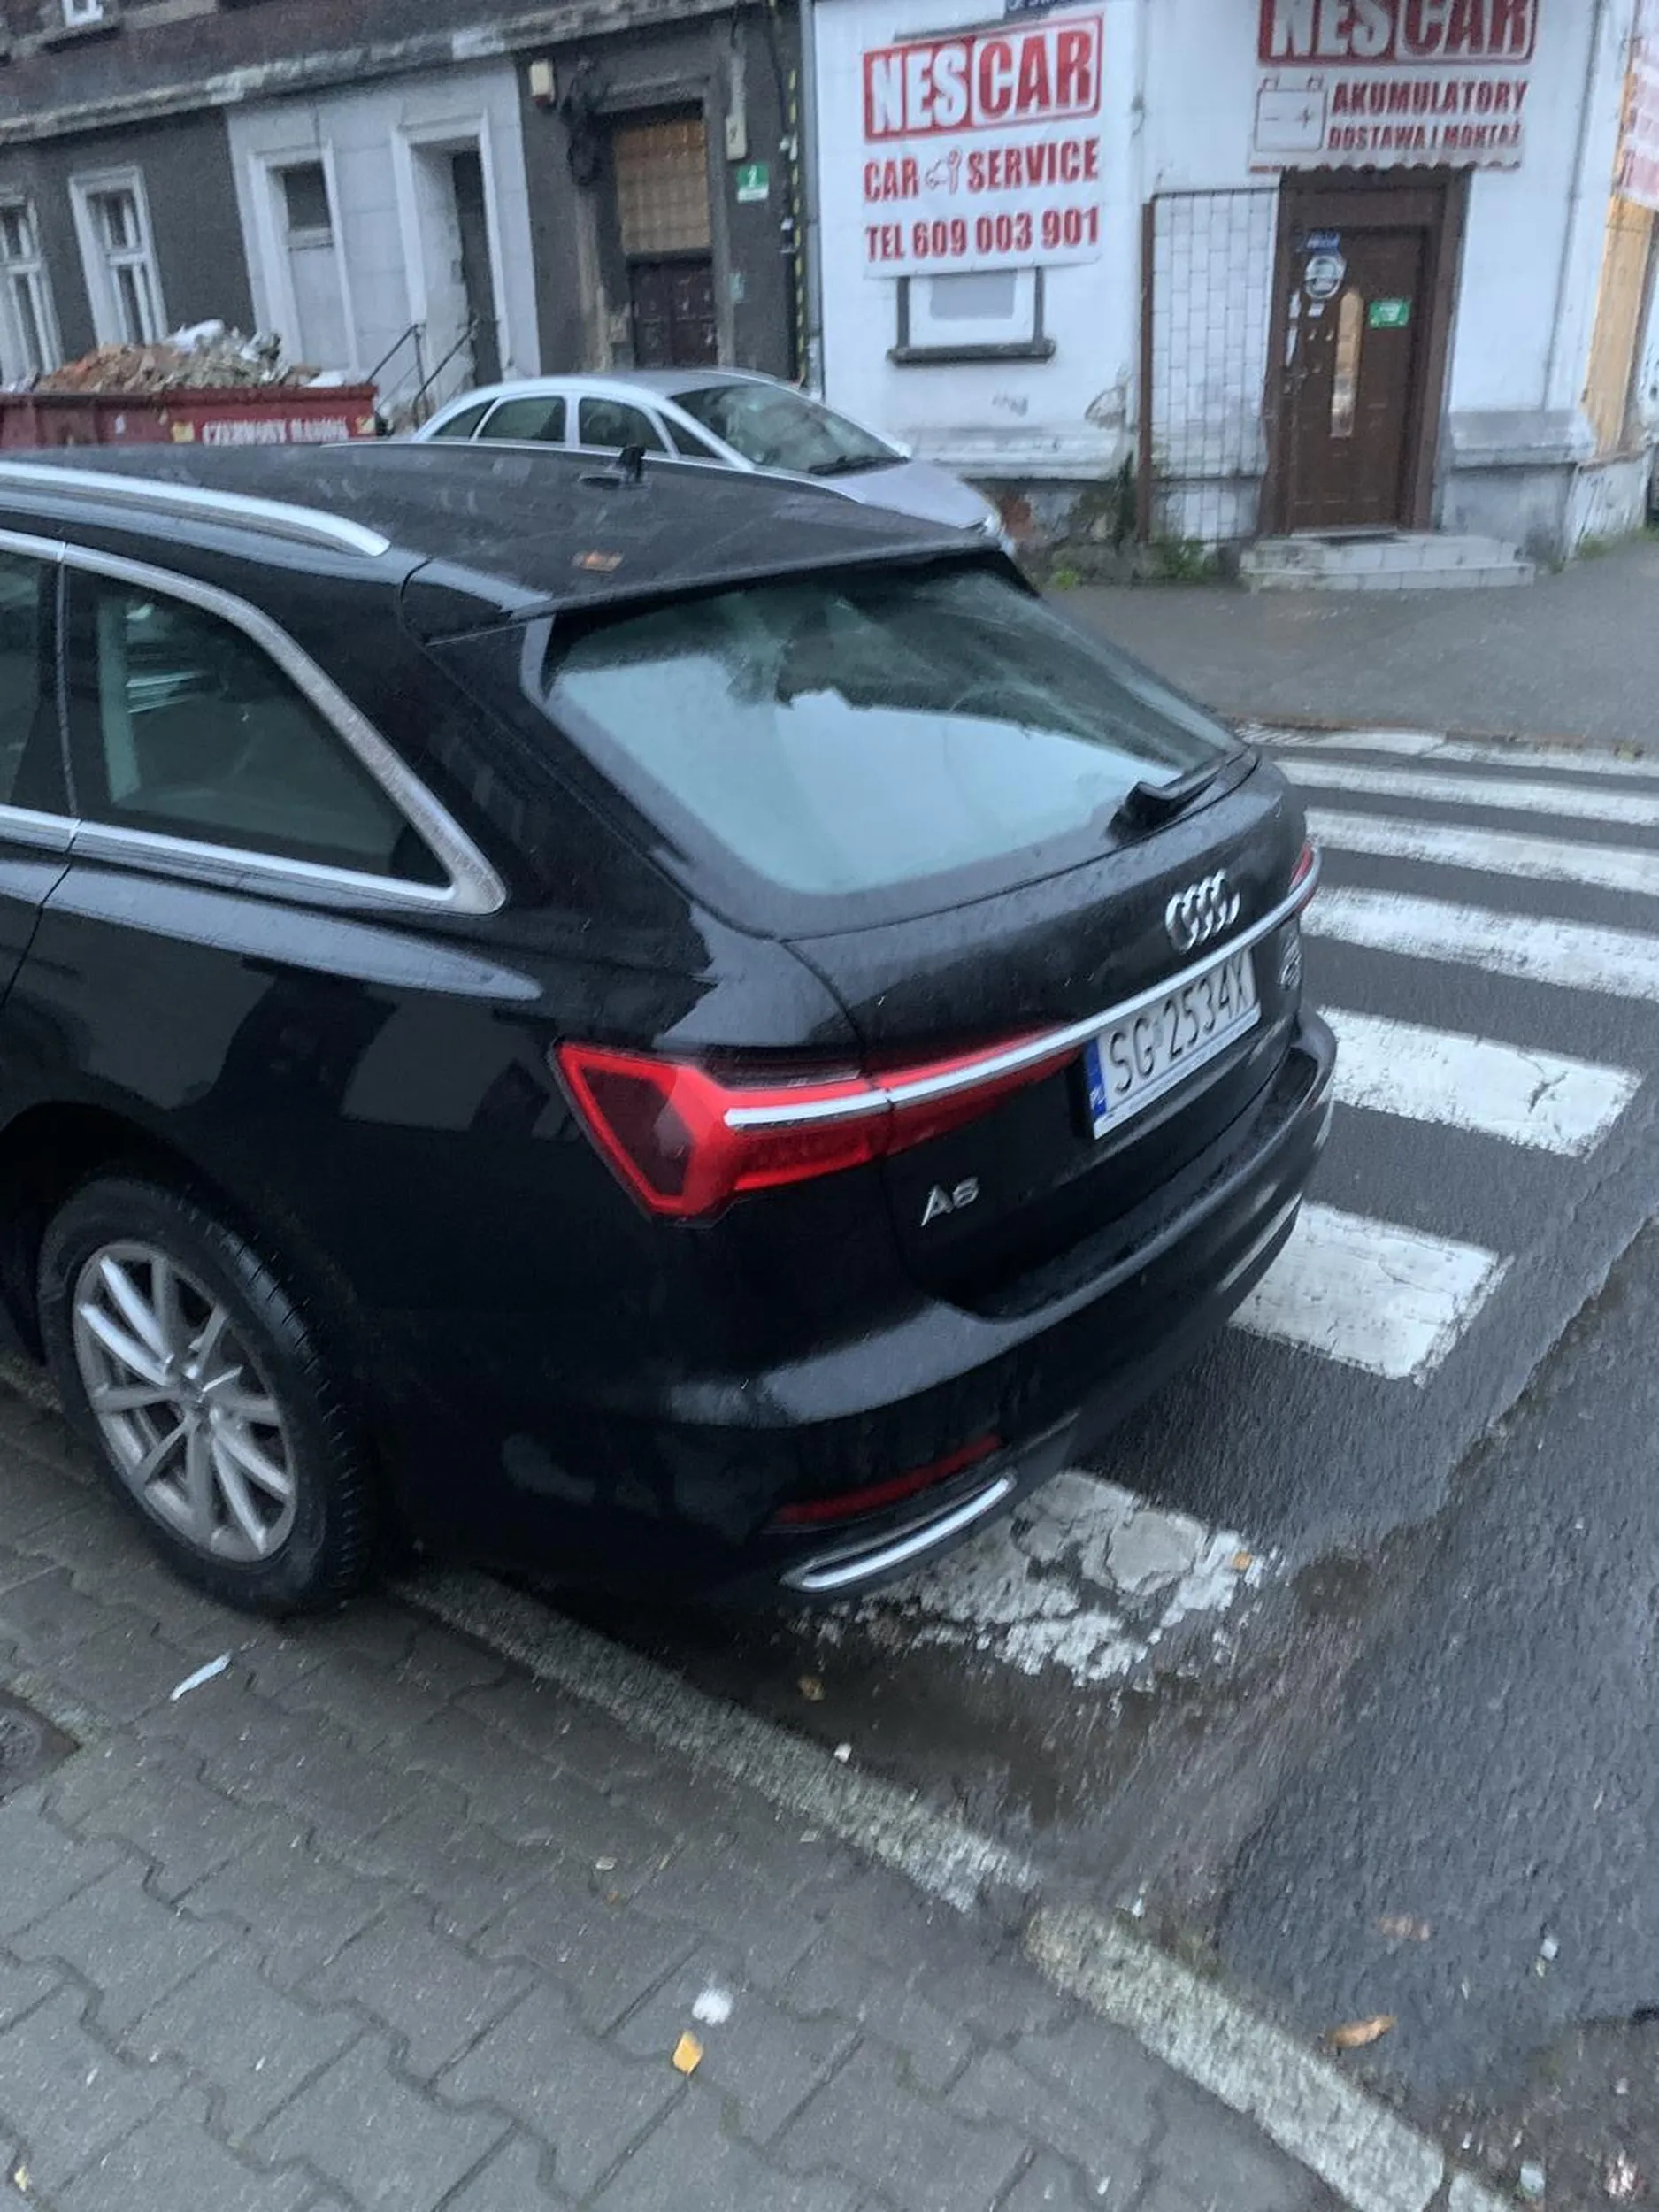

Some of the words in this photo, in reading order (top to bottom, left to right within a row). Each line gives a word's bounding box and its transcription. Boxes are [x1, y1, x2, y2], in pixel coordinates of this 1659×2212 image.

[1270, 0, 1529, 56] NESCAR
[871, 30, 1092, 134] NESCAR
[1331, 81, 1529, 117] AKUMULATORY
[1328, 124, 1426, 151] DOSTAWA
[864, 157, 918, 202] CAR
[967, 137, 1100, 194] SERVICE
[865, 223, 904, 262] TEL
[912, 219, 967, 259] 609
[976, 212, 1033, 254] 003
[1041, 206, 1099, 249] 901
[1110, 1017, 1156, 1094] SG
[921, 1177, 979, 1227] A6
